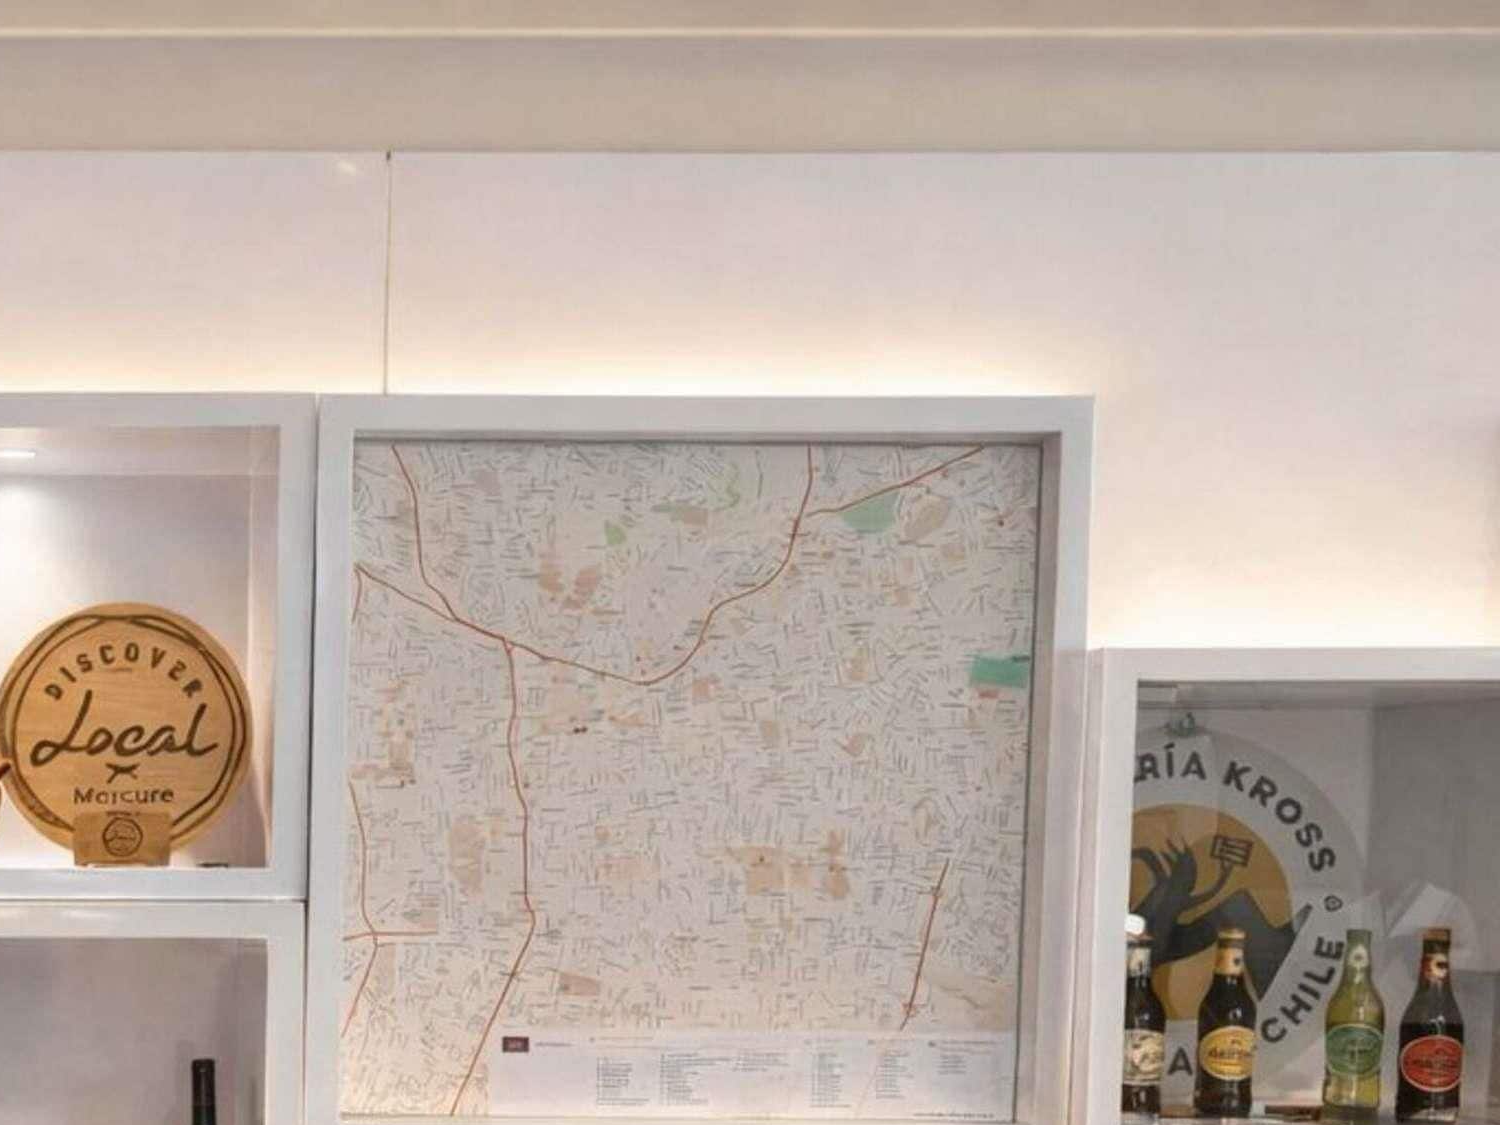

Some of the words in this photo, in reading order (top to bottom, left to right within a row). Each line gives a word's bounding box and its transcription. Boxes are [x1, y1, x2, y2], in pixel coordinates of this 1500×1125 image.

[44, 641, 203, 701] DISCOVER
[30, 689, 219, 767] Local
[1133, 741, 1207, 783] RÍA
[1222, 760, 1336, 873] KROSS
[1260, 935, 1345, 1044] CHILE
